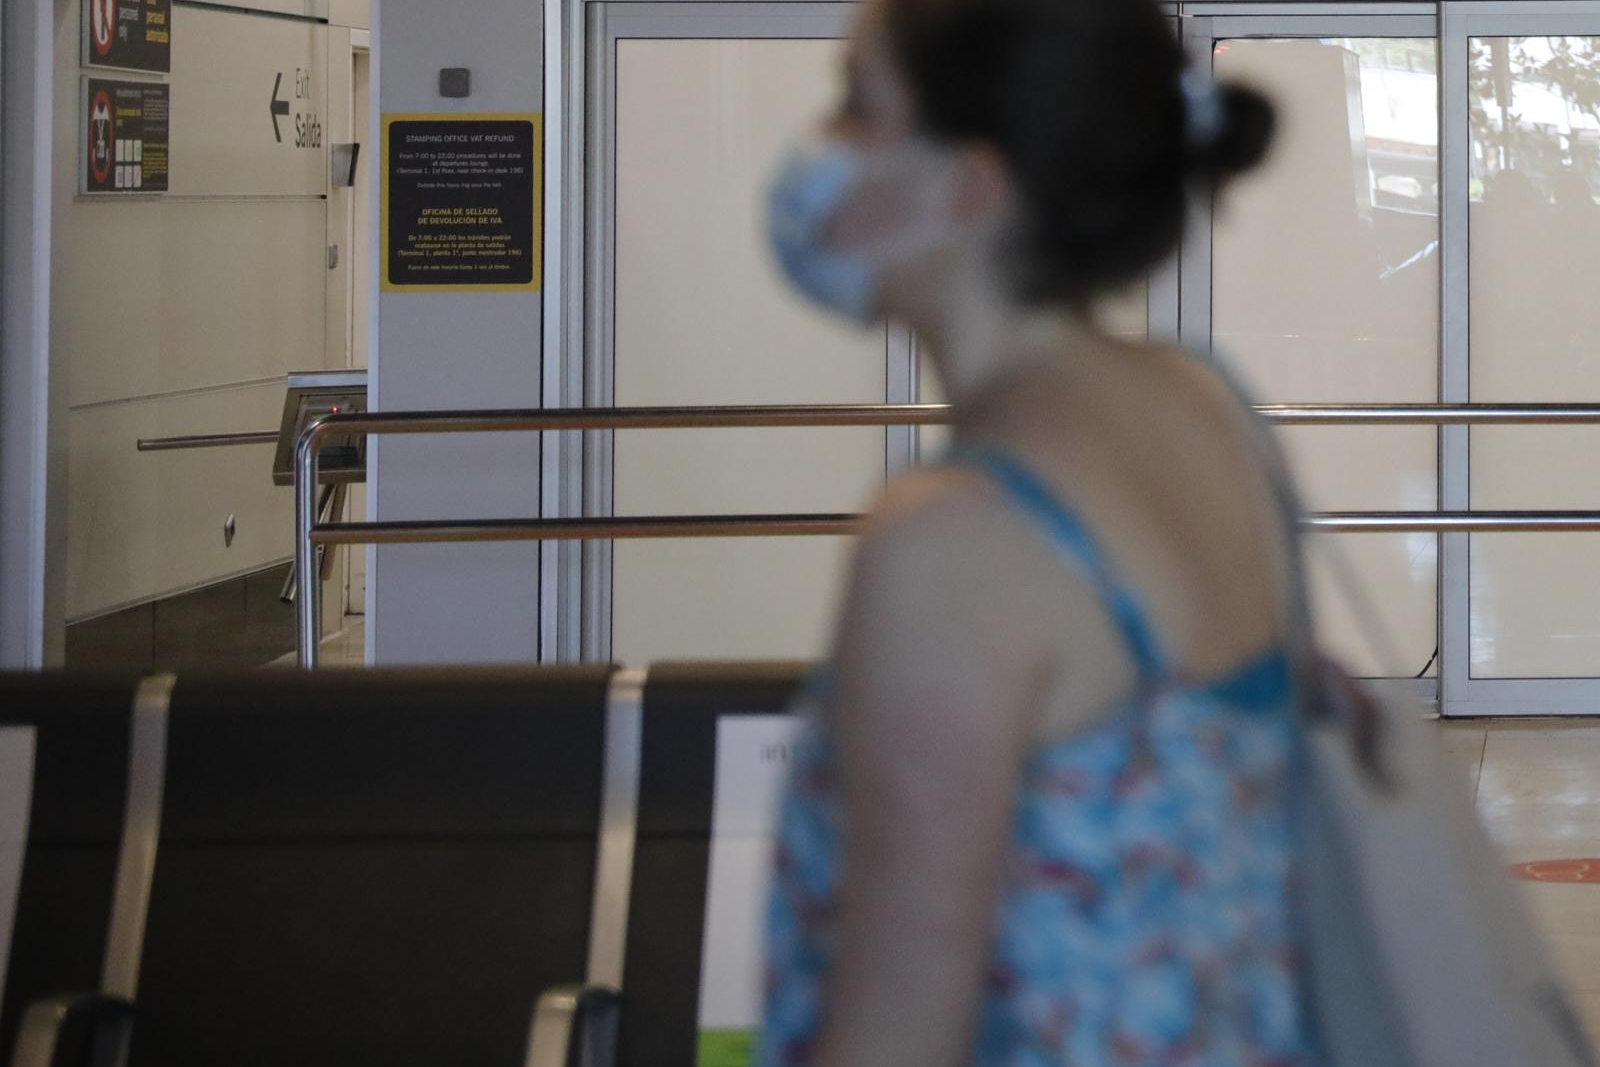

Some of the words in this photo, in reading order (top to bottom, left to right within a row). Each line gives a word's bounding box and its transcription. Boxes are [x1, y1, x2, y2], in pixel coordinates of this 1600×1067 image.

[296, 67, 309, 99] Exit
[295, 112, 321, 148] Salida
[406, 134, 442, 142] STAMPING
[443, 134, 468, 142] OFFICE
[470, 134, 484, 142] VAT
[484, 134, 515, 142] REFUND
[429, 216, 476, 224] DEVOLUCIÓN
